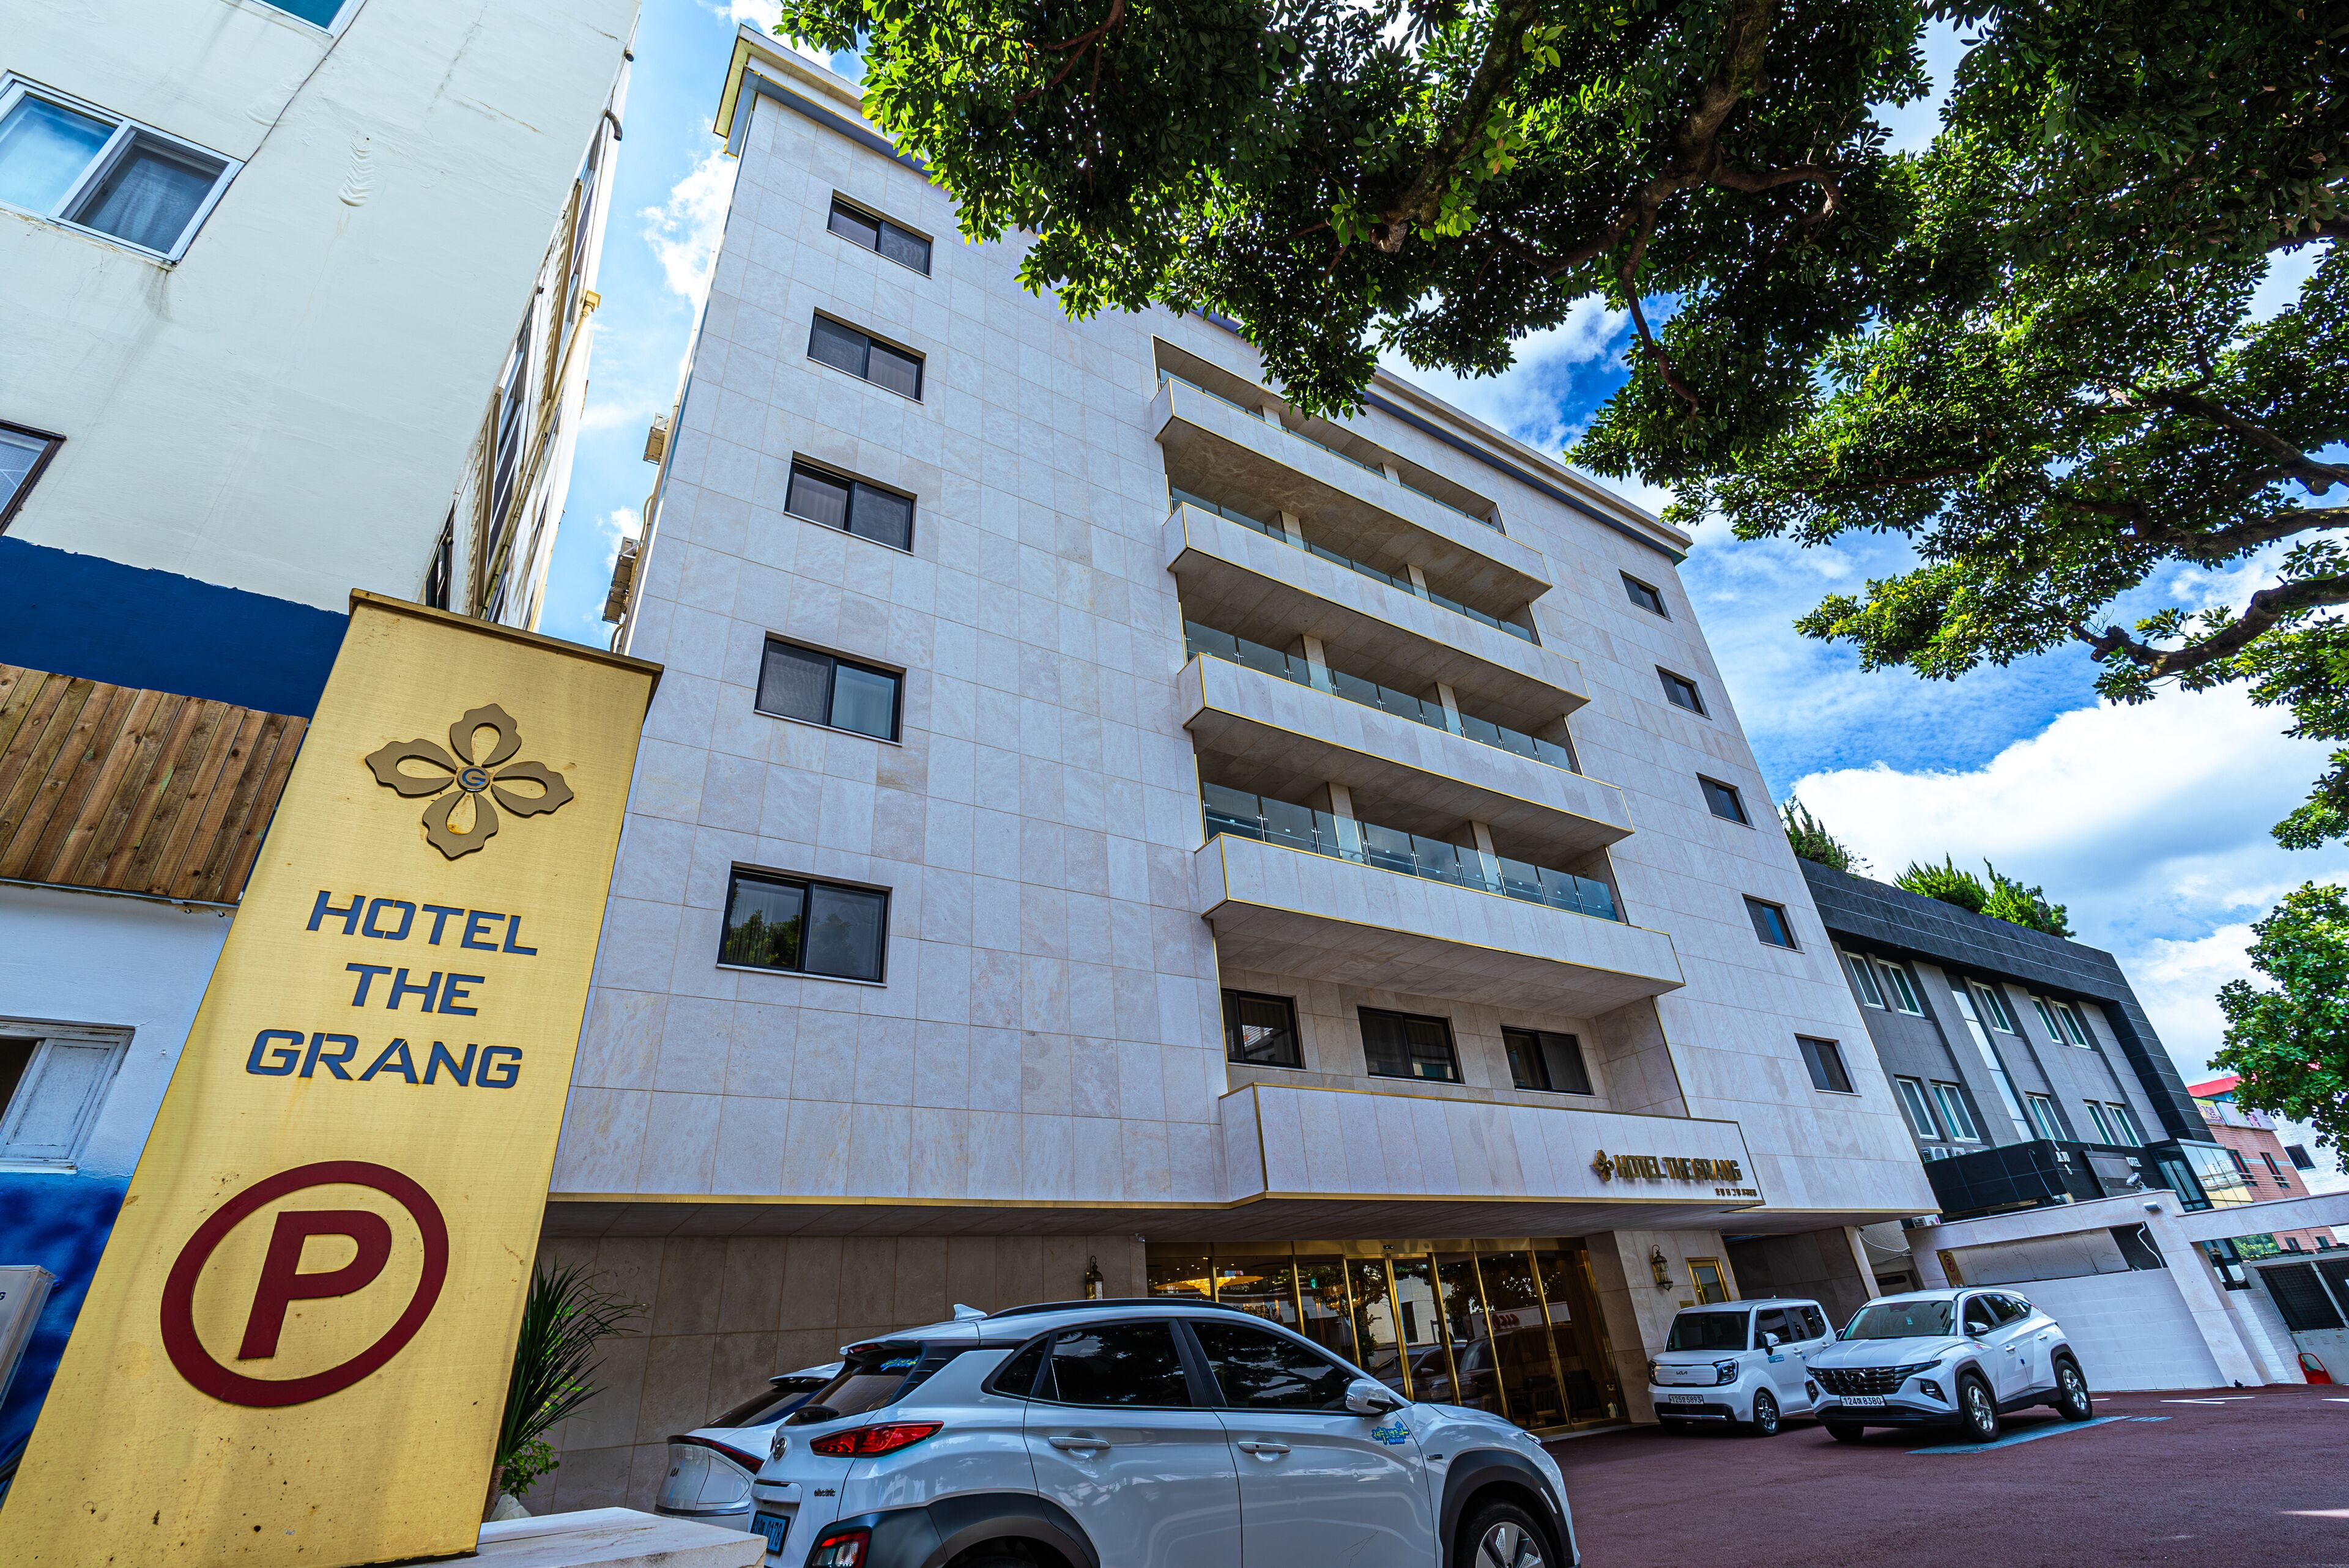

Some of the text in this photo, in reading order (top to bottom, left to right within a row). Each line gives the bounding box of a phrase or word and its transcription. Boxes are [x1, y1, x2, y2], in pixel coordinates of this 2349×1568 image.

[462, 769, 485, 786] G
[306, 890, 537, 956] HOTEL
[346, 963, 484, 1016] THE
[247, 1030, 522, 1089] GRANG
[1613, 1155, 1743, 1182] HOTEL THE GRANG
[238, 1210, 393, 1359] P
[814, 1488, 836, 1496] electric
